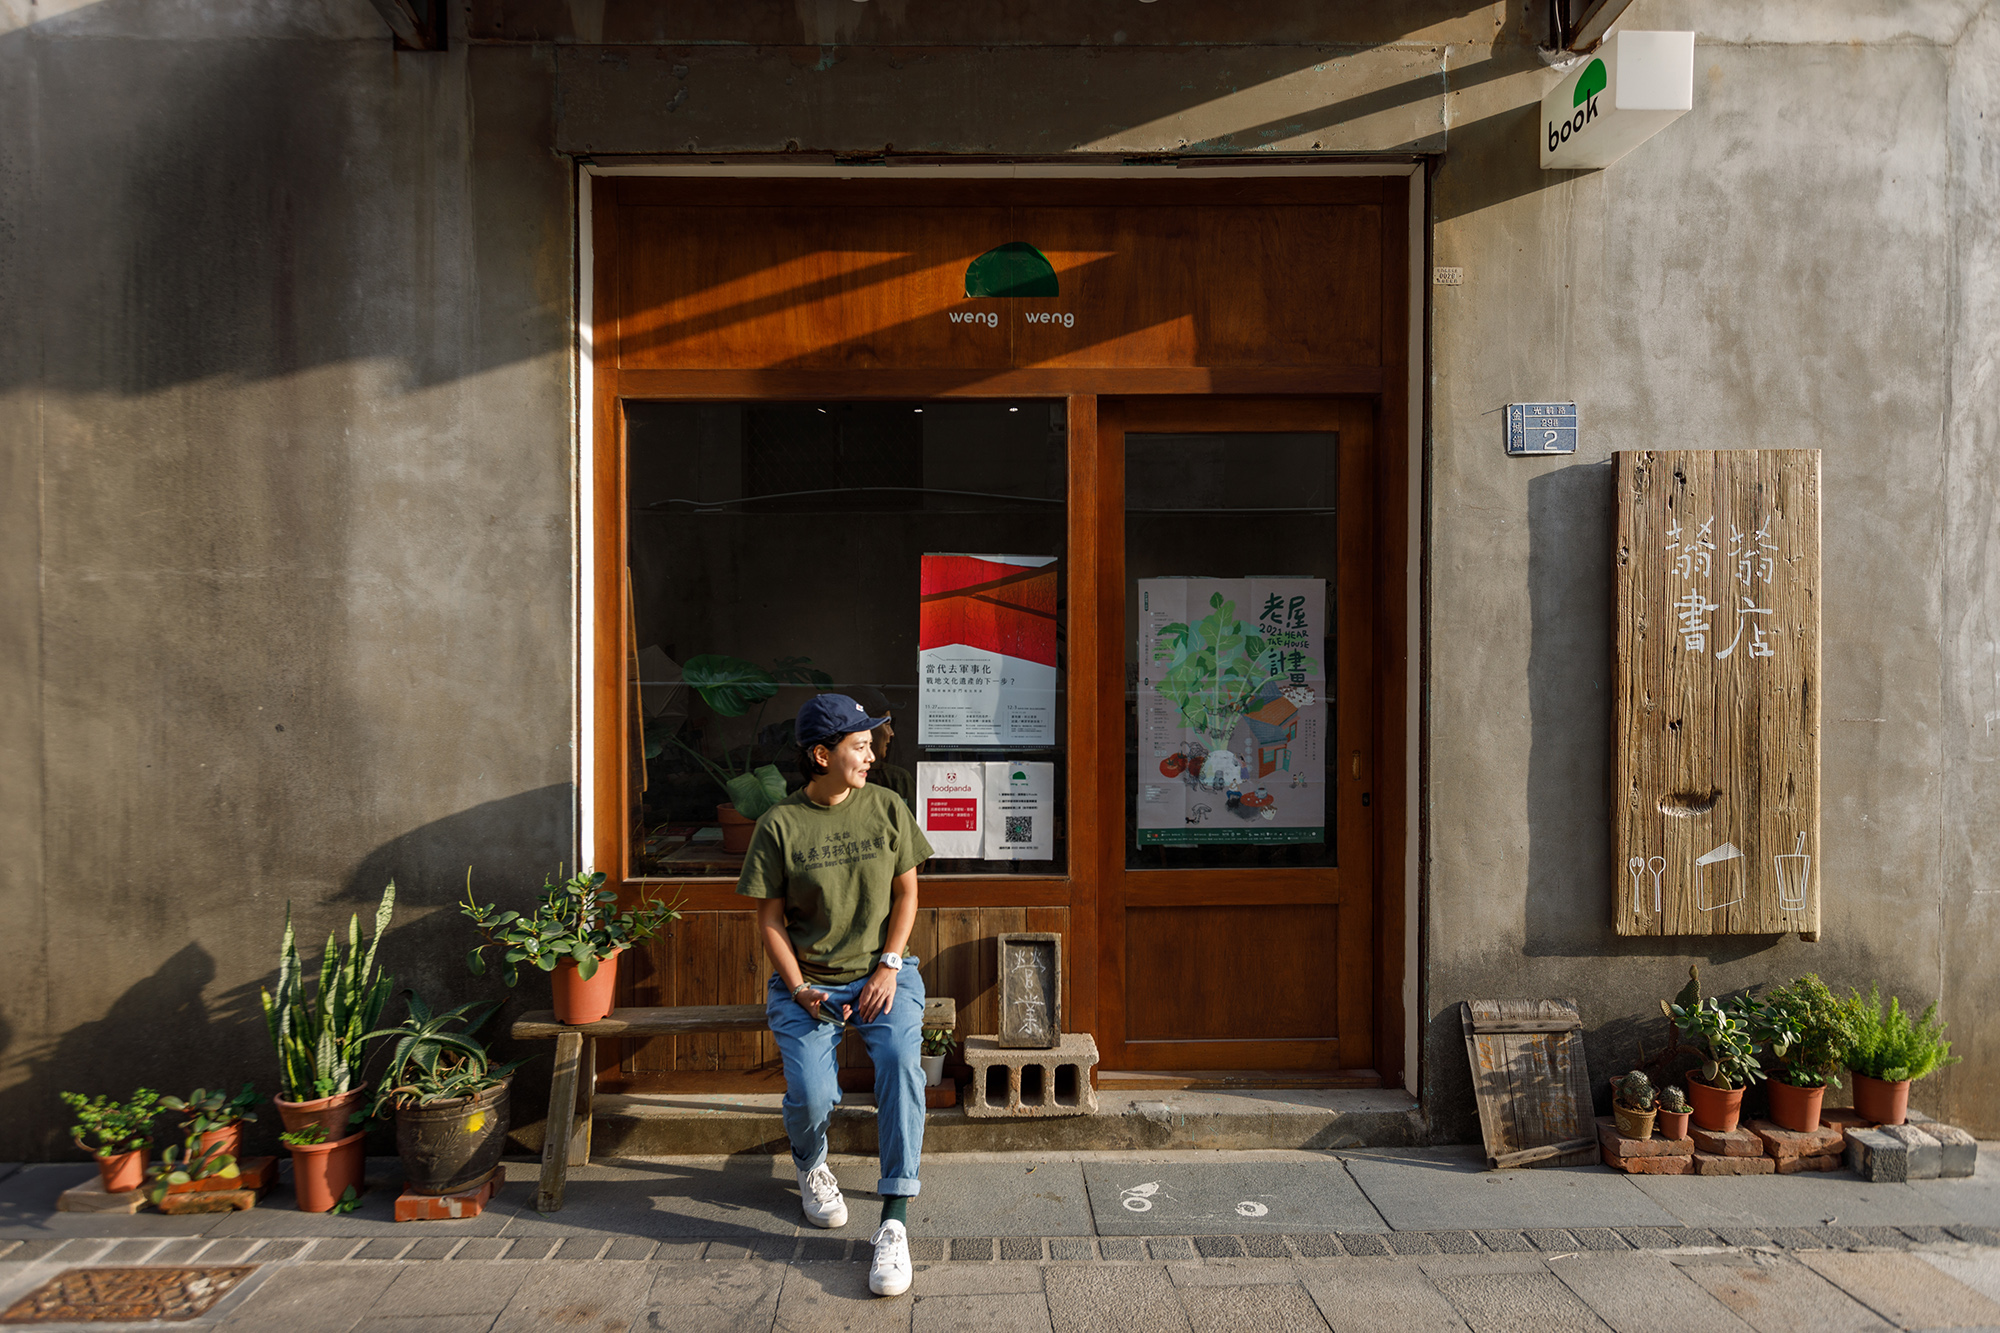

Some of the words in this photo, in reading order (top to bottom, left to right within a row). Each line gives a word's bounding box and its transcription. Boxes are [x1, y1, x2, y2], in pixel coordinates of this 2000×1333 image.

[1548, 88, 1599, 152] book
[949, 312, 999, 328] weng
[1025, 312, 1075, 328] weng
[1511, 409, 1523, 448] 金城鎮
[1543, 430, 1558, 450] 2
[1259, 592, 1309, 629] 老屋
[1259, 623, 1283, 637] 2021
[1284, 630, 1309, 640] HEAR
[1673, 588, 1775, 660] 書店
[1284, 639, 1310, 649] HOUSE
[925, 664, 992, 674] 當代去軍事化
[1268, 648, 1309, 687] 計畫
[931, 784, 972, 793] foodpanda
[825, 832, 851, 843] 大高雄
